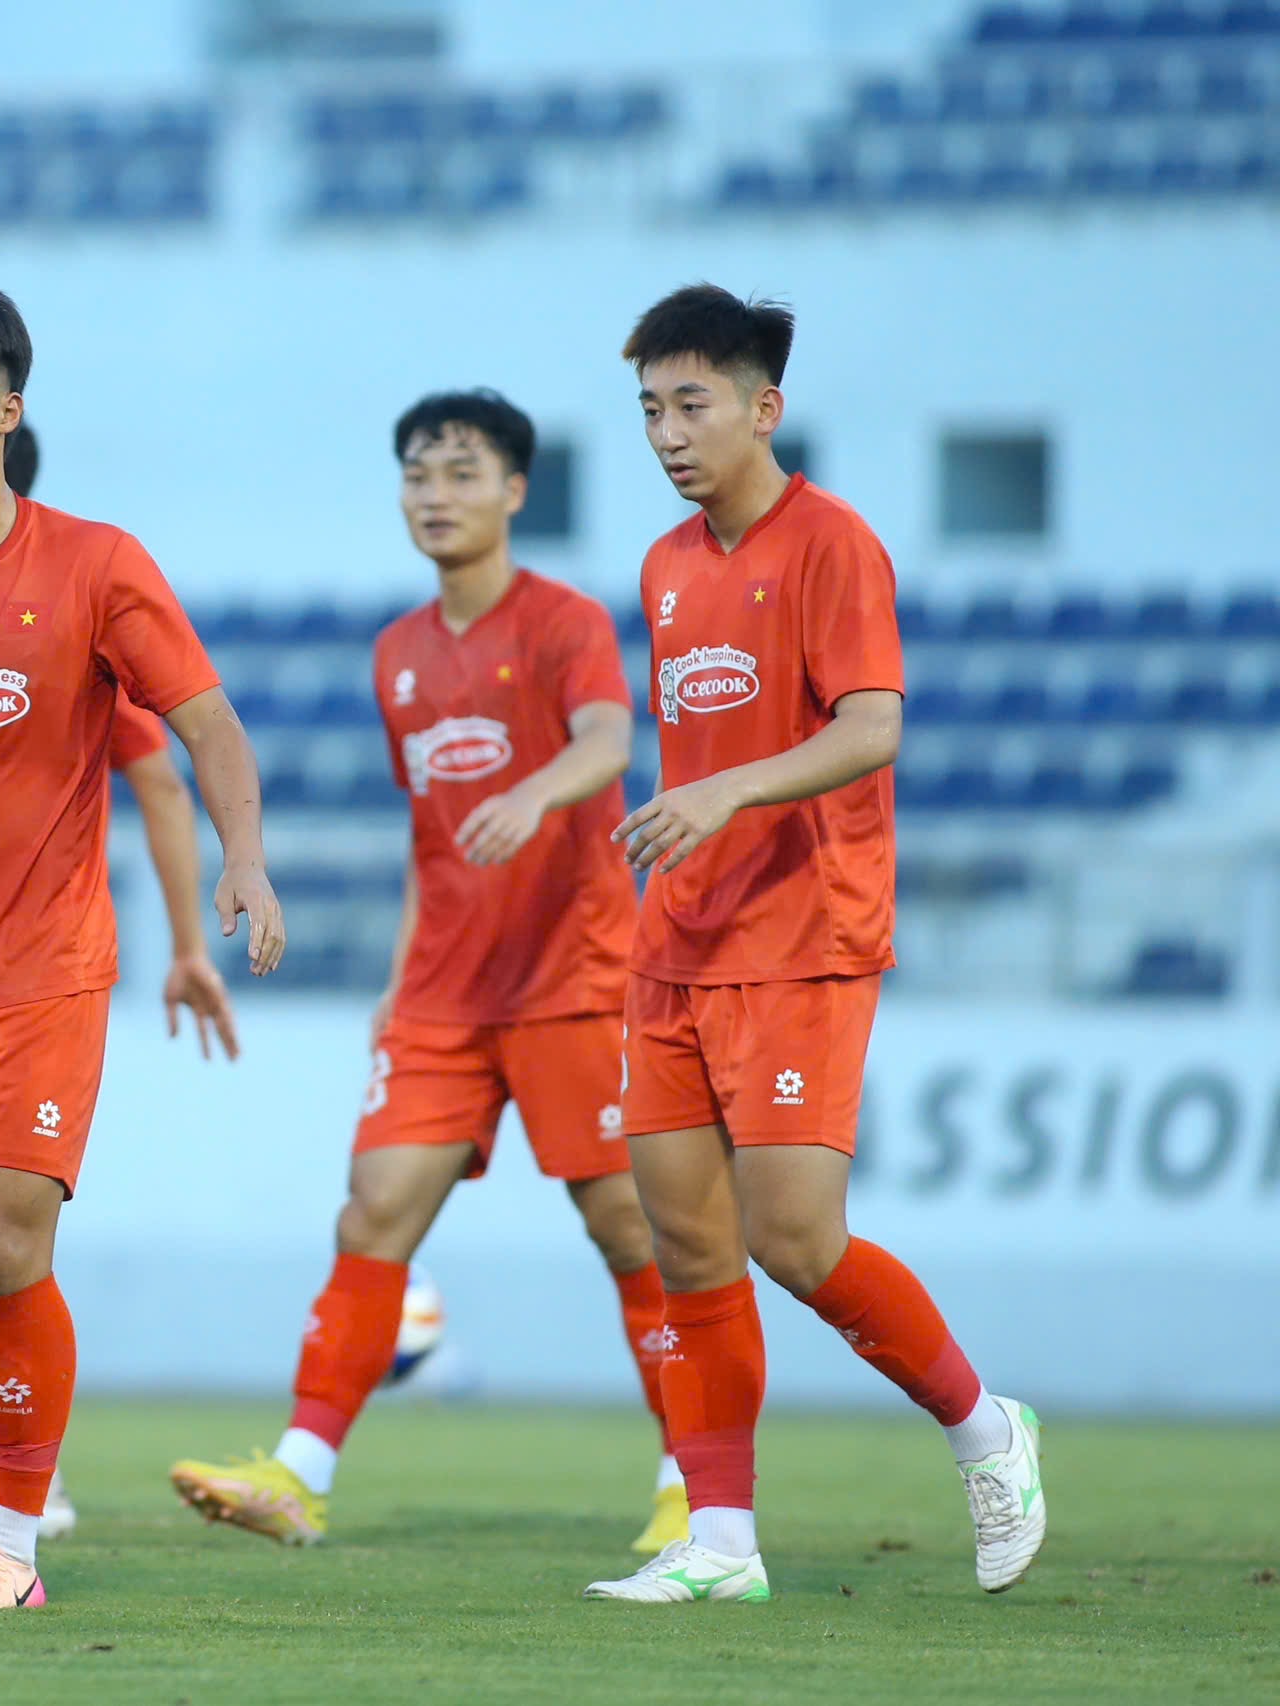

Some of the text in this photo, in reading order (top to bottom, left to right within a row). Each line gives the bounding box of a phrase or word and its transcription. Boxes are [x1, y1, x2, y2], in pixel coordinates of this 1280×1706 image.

[675, 648, 754, 673] Cook happiness
[852, 1060, 1280, 1198] SSIO
